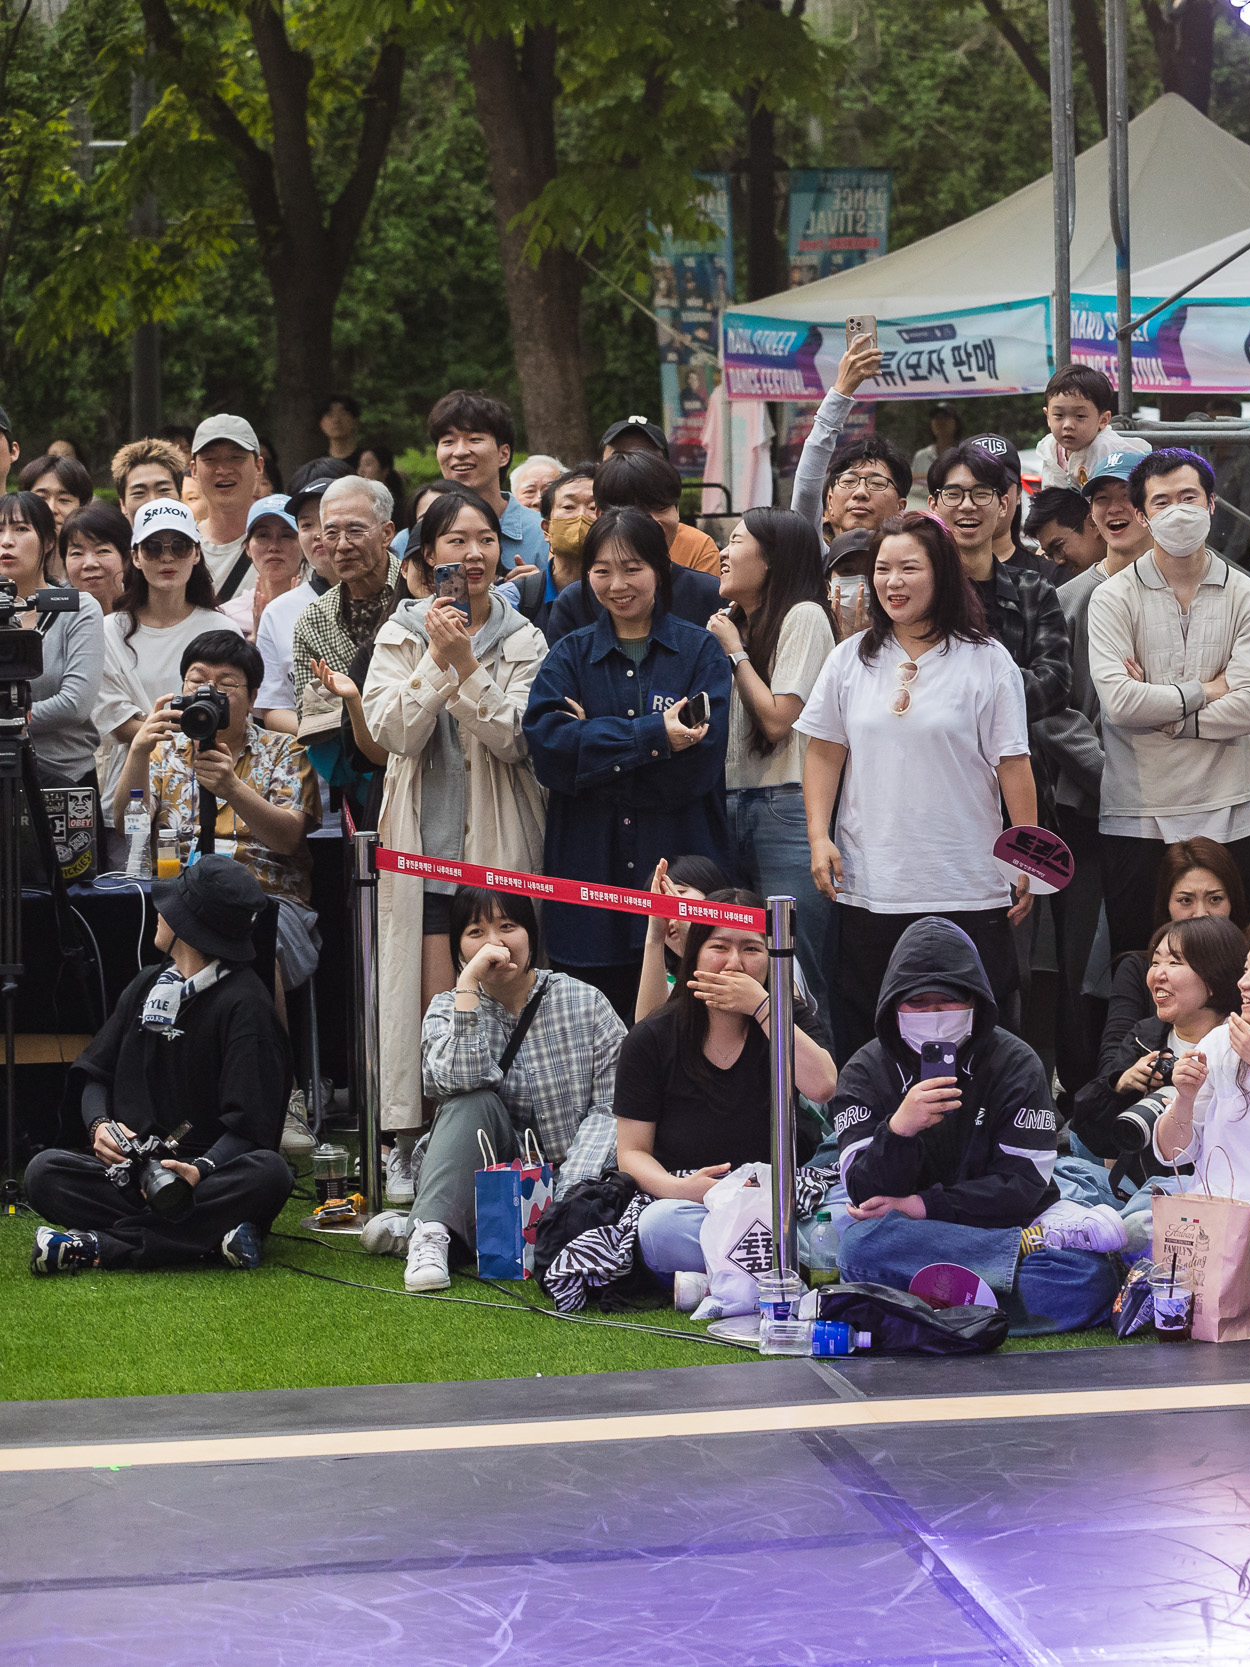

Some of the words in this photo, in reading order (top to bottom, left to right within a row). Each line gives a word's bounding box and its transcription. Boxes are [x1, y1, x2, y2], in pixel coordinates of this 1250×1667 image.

[752, 330, 798, 357] STREET
[952, 338, 999, 383] 판매
[143, 506, 189, 527] SRIXON
[70, 818, 92, 828] OBEY
[63, 852, 92, 878] ICKIES
[405, 859, 432, 873] 광진문화재단
[436, 864, 462, 878] 나루아트센터
[494, 874, 522, 889] 광진문화재단
[527, 880, 554, 894] 나루아트센터
[589, 889, 618, 904] 광진문화재단
[623, 895, 652, 909] 나루아트센터
[687, 905, 719, 919] 광진문화재단
[724, 910, 754, 924] 나루아트센터
